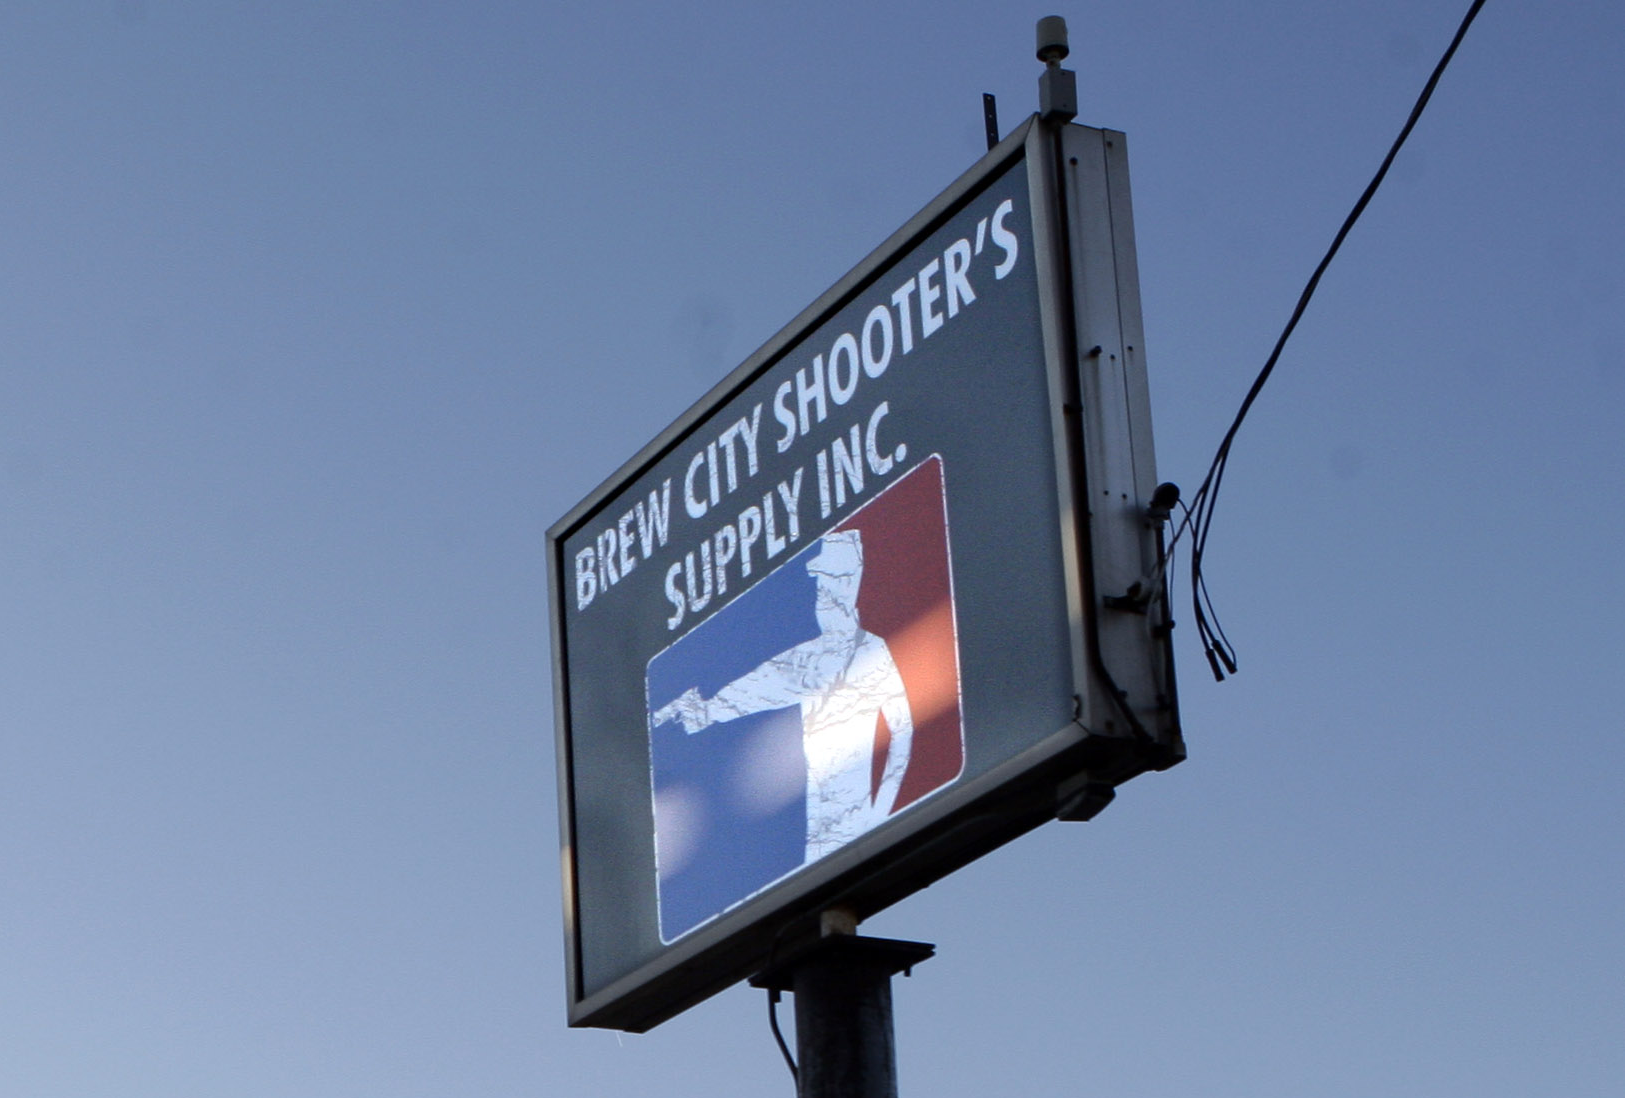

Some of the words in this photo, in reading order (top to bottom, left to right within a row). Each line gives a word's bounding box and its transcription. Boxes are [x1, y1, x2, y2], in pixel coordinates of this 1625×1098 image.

[575, 479, 672, 612] BREW
[683, 403, 763, 519] CITY
[774, 198, 1018, 454] SHOOTER'S
[665, 468, 804, 631] SUPPLY
[815, 402, 908, 520] INC.
